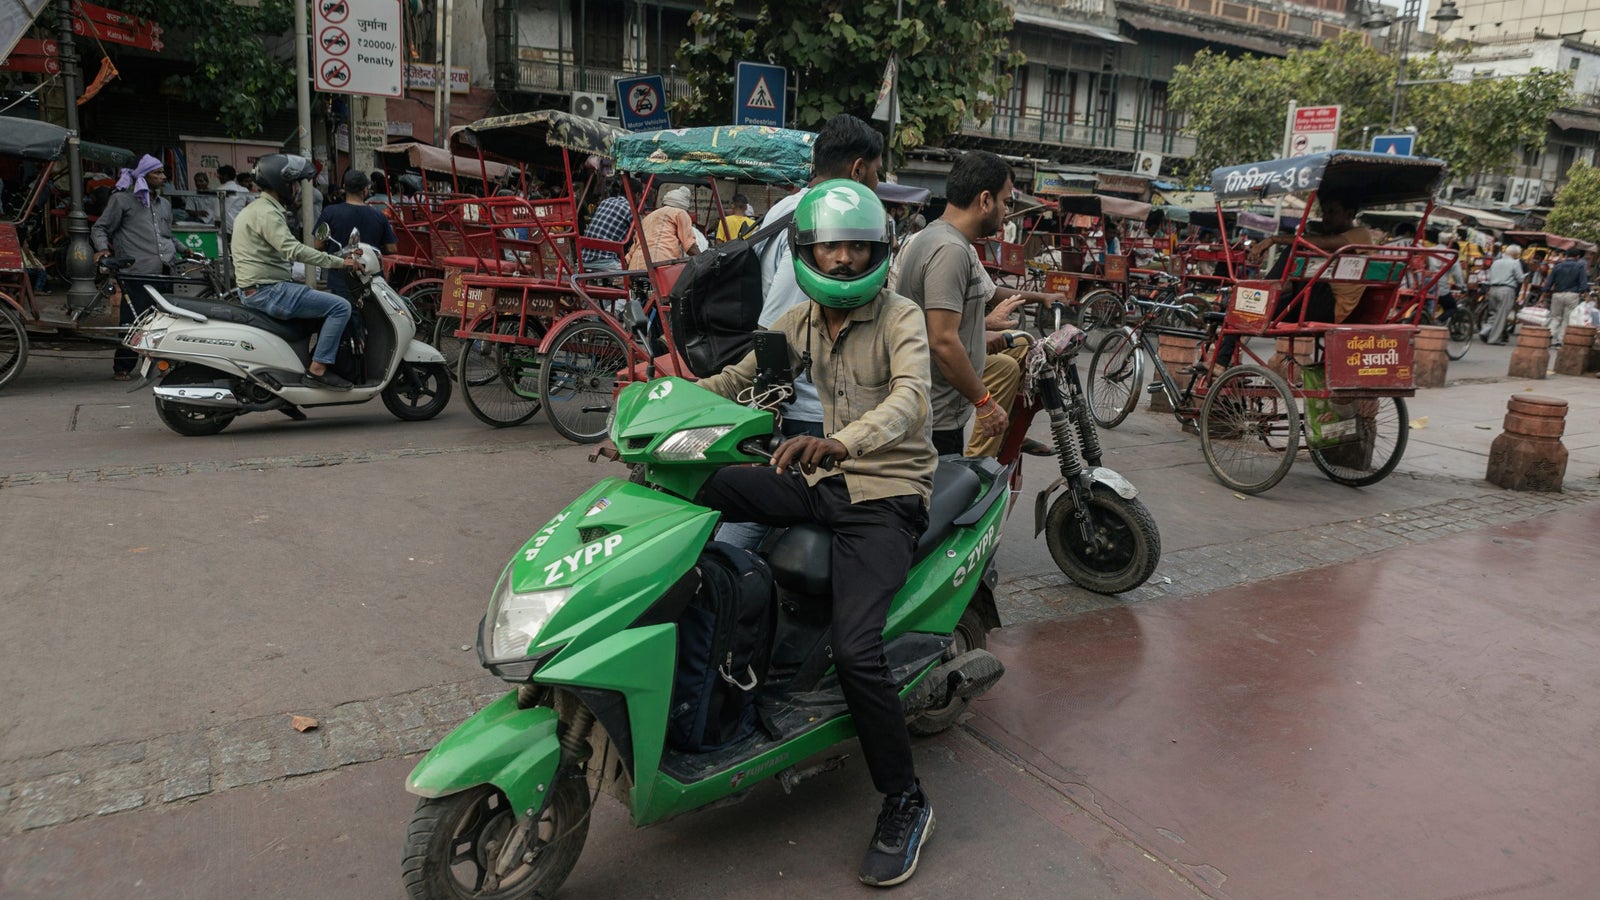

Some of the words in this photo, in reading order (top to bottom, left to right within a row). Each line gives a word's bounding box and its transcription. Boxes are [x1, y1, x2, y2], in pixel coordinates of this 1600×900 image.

[357, 18, 388, 32] जुर्माना
[357, 54, 395, 68] Penalty
[627, 122, 644, 131] Motor
[644, 118, 668, 126] Vehicles
[744, 117, 777, 126] Pedestrian
[1346, 352, 1361, 366] की
[1362, 348, 1399, 366] सवारी!
[524, 511, 571, 562] ZYPP
[966, 524, 995, 574] ZYPP
[543, 534, 623, 587] ZYPP
